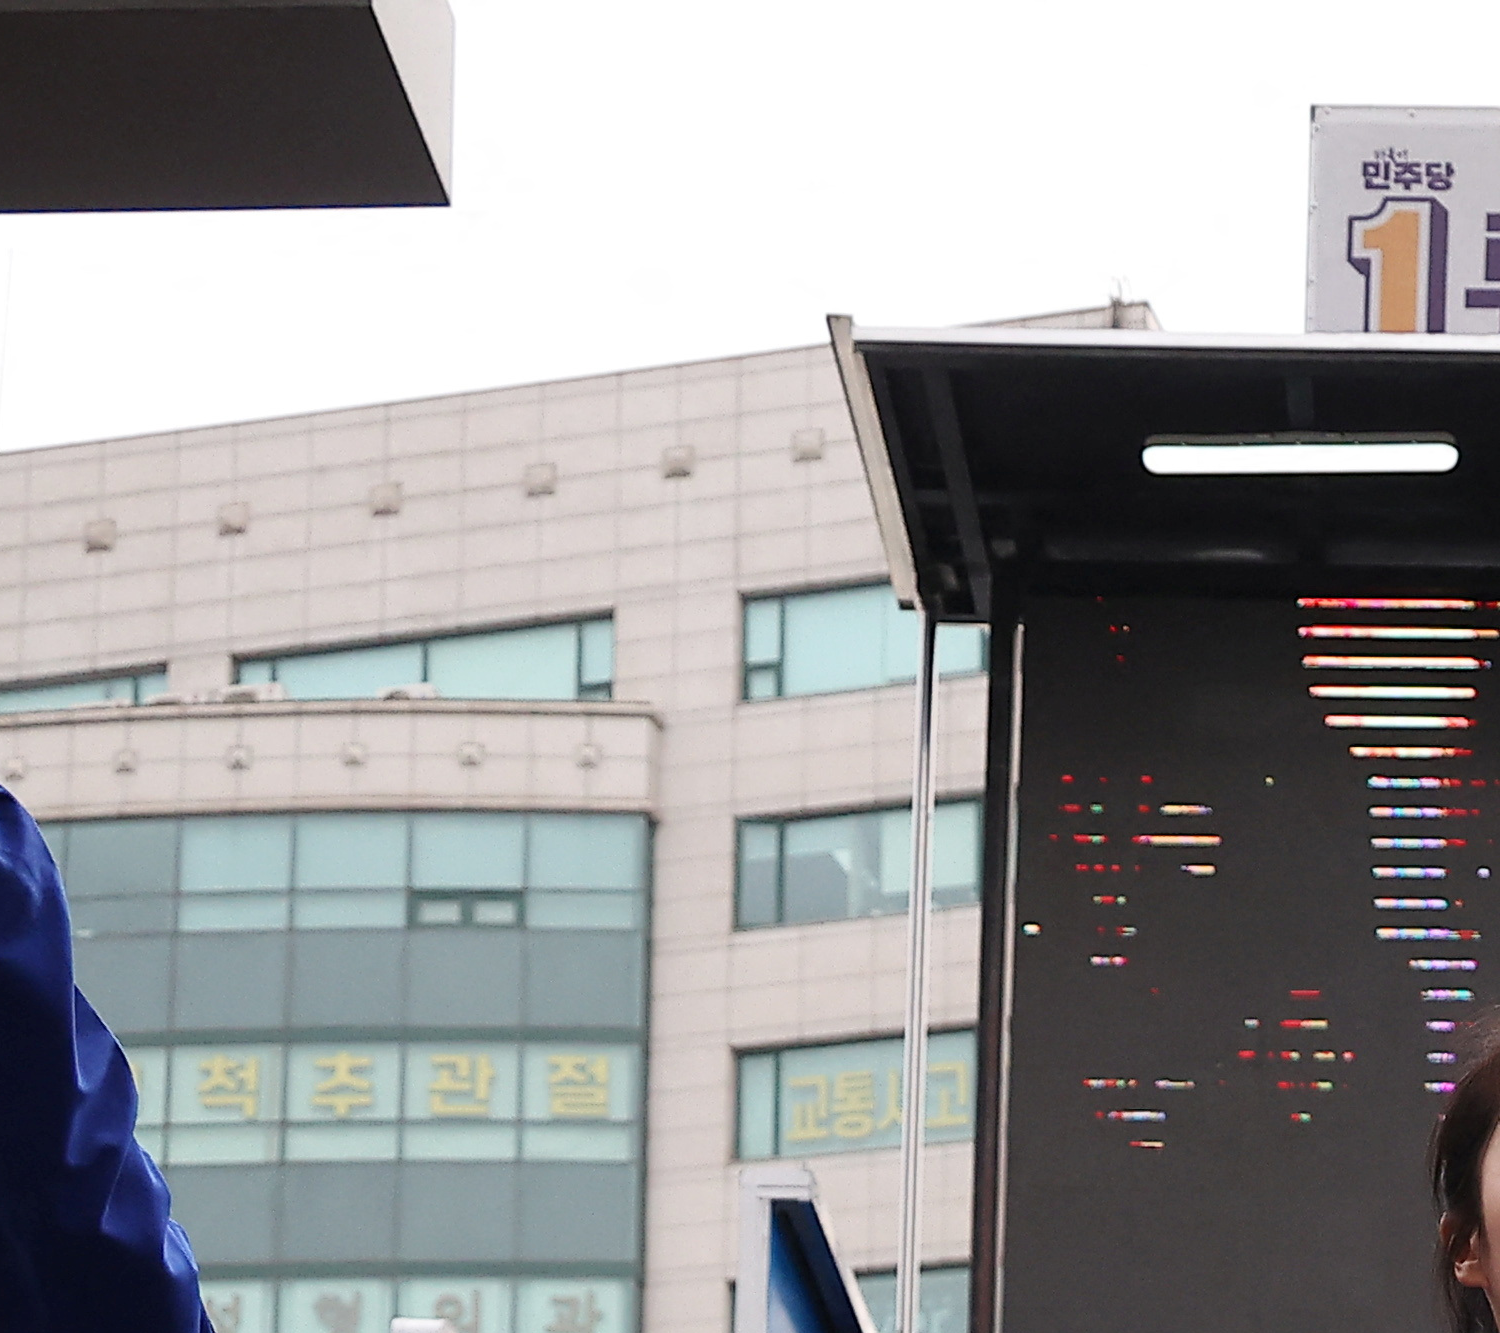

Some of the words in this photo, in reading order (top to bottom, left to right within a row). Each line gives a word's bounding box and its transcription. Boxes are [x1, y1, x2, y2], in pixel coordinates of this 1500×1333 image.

[1362, 161, 1455, 190] 민주당
[1348, 196, 1448, 333] 1
[197, 1052, 610, 1120] 척추관절
